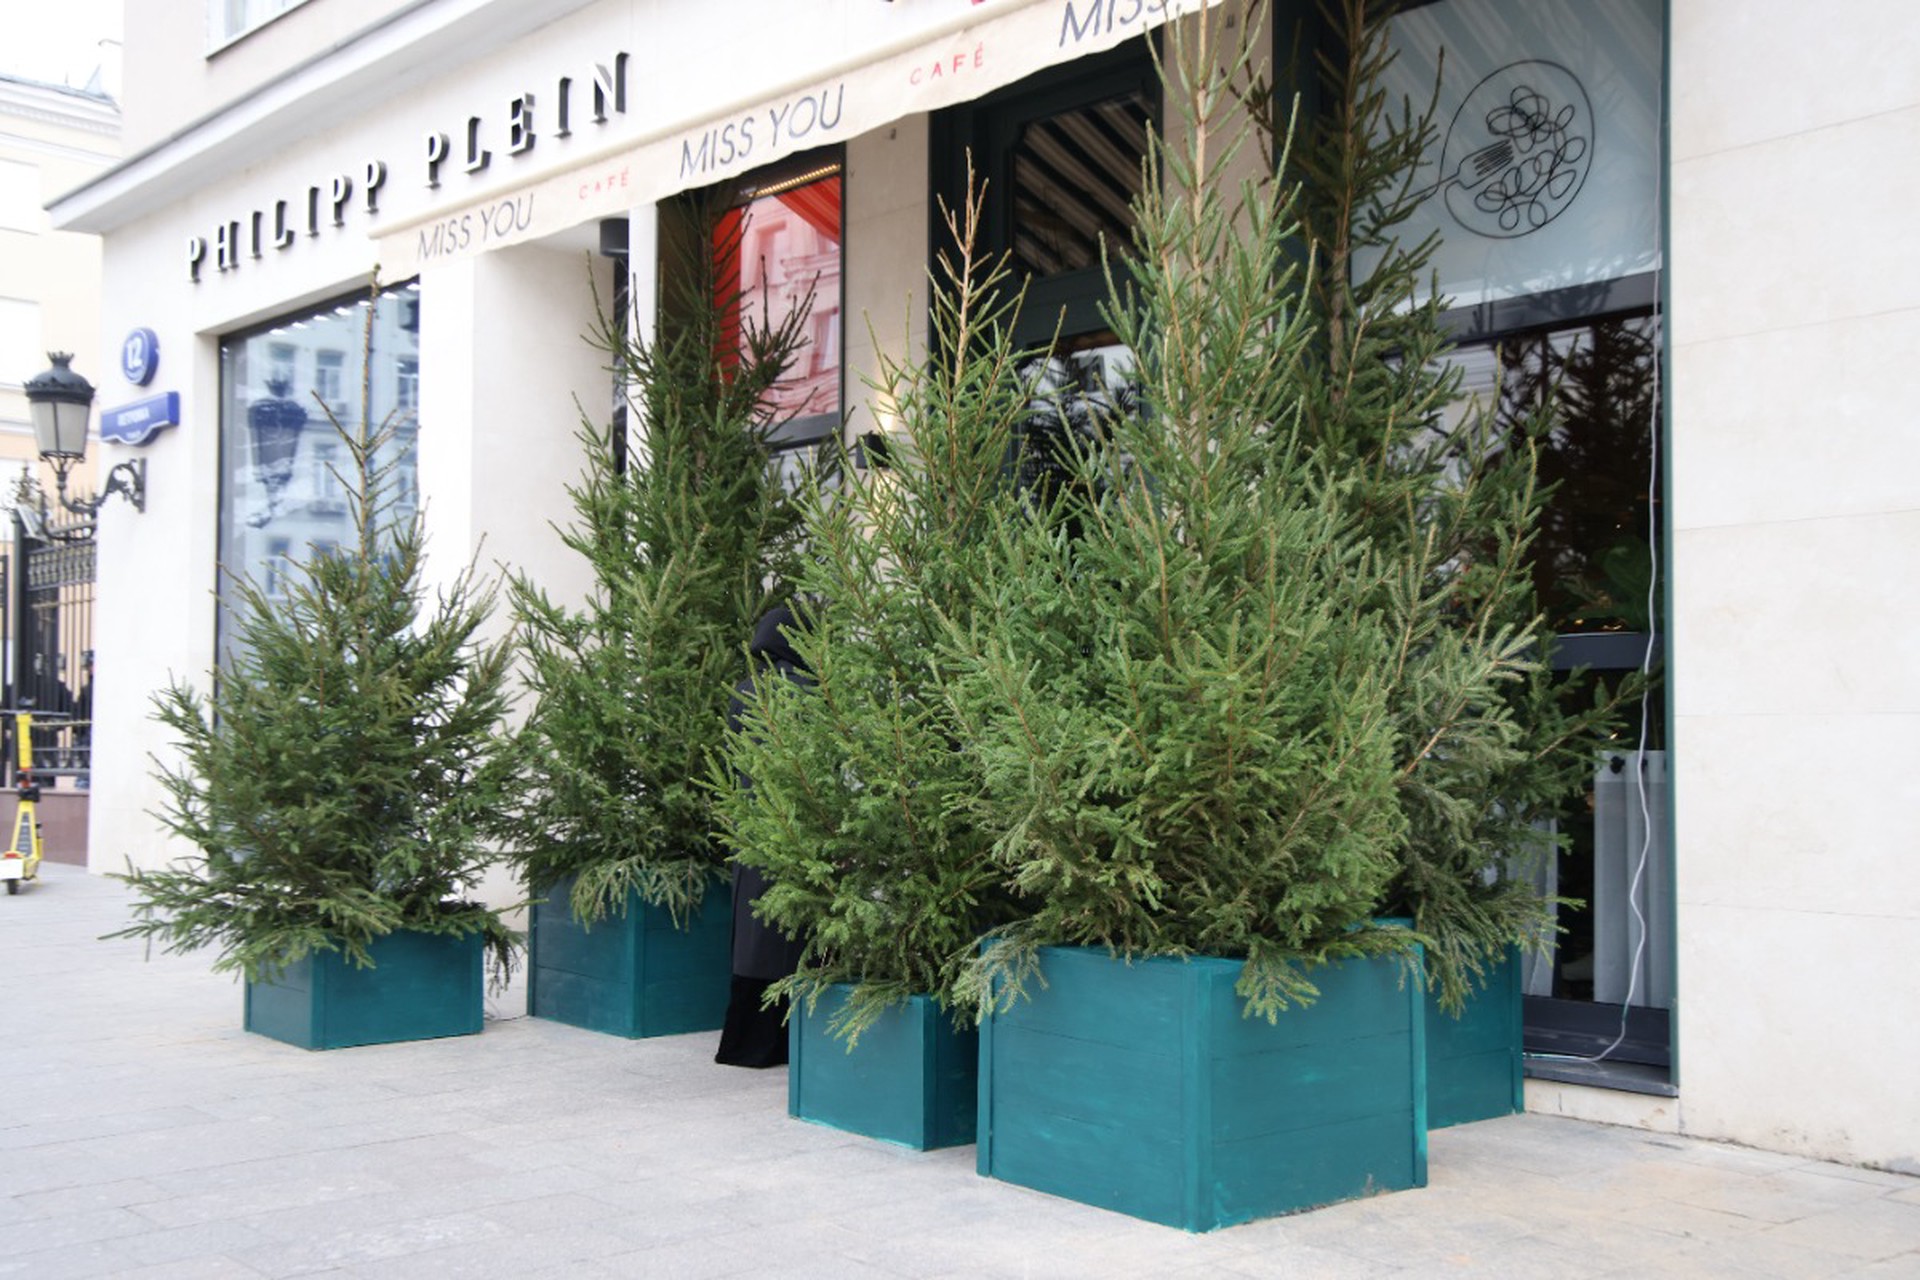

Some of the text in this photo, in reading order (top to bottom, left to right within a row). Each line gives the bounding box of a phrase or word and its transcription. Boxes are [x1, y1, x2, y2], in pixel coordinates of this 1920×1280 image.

[1058, 0, 1167, 47] MIS
[909, 42, 984, 86] CAFÉ
[679, 83, 845, 179] MISS YOU
[187, 50, 631, 283] PHILIPP PLEIN
[578, 166, 630, 200] CAFÉ
[417, 192, 534, 262] MISS YOU
[126, 336, 143, 370] 12
